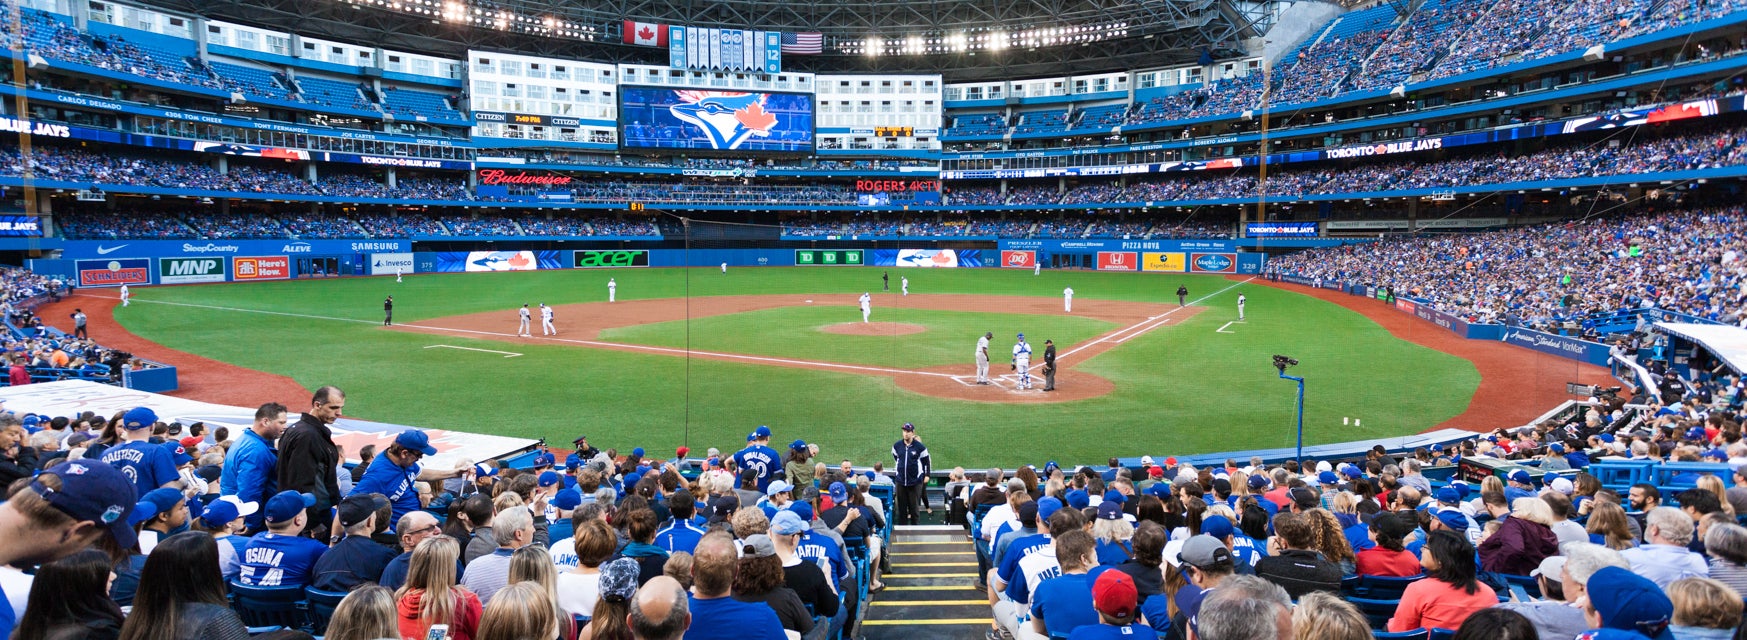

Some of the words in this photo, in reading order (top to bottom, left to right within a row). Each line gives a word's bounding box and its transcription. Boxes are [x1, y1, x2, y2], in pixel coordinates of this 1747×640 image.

[767, 50, 778, 60] 12
[58, 95, 87, 105] CARLOS
[89, 100, 122, 110] DELGADO
[475, 113, 505, 121] CITIZEN
[552, 118, 580, 126] CITIZEN
[33, 122, 70, 138] JAYS
[273, 124, 308, 134] FERNANDEZ
[1326, 145, 1375, 159] TORONTO
[1386, 141, 1412, 154] BLUE
[1413, 138, 1442, 151] JAYS
[361, 156, 398, 165] TORONTO
[405, 158, 424, 167] BLUE
[424, 160, 441, 168] JAYS
[479, 169, 571, 185] Budweiser
[856, 180, 906, 191] ROGERS
[909, 180, 924, 191] 4K
[926, 180, 941, 191] TV
[13, 222, 37, 231] JAYS
[351, 242, 399, 250] SAMSUNG
[1143, 242, 1160, 250] NOVA
[580, 251, 643, 267] acer
[802, 253, 812, 261] TD
[825, 253, 835, 261] TD
[848, 253, 859, 261] TD
[169, 259, 217, 275] MNP
[258, 260, 286, 269] Here's
[385, 259, 412, 268] Invesco
[258, 268, 281, 276] How.
[1510, 330, 1534, 343] American
[1533, 334, 1561, 349] Standard
[101, 448, 144, 464] BAUTISTA
[743, 451, 772, 465] DONALDSON
[746, 460, 767, 478] 20
[389, 478, 409, 502] BLUE
[1233, 537, 1255, 549] UNA
[245, 547, 285, 567] OSUNA
